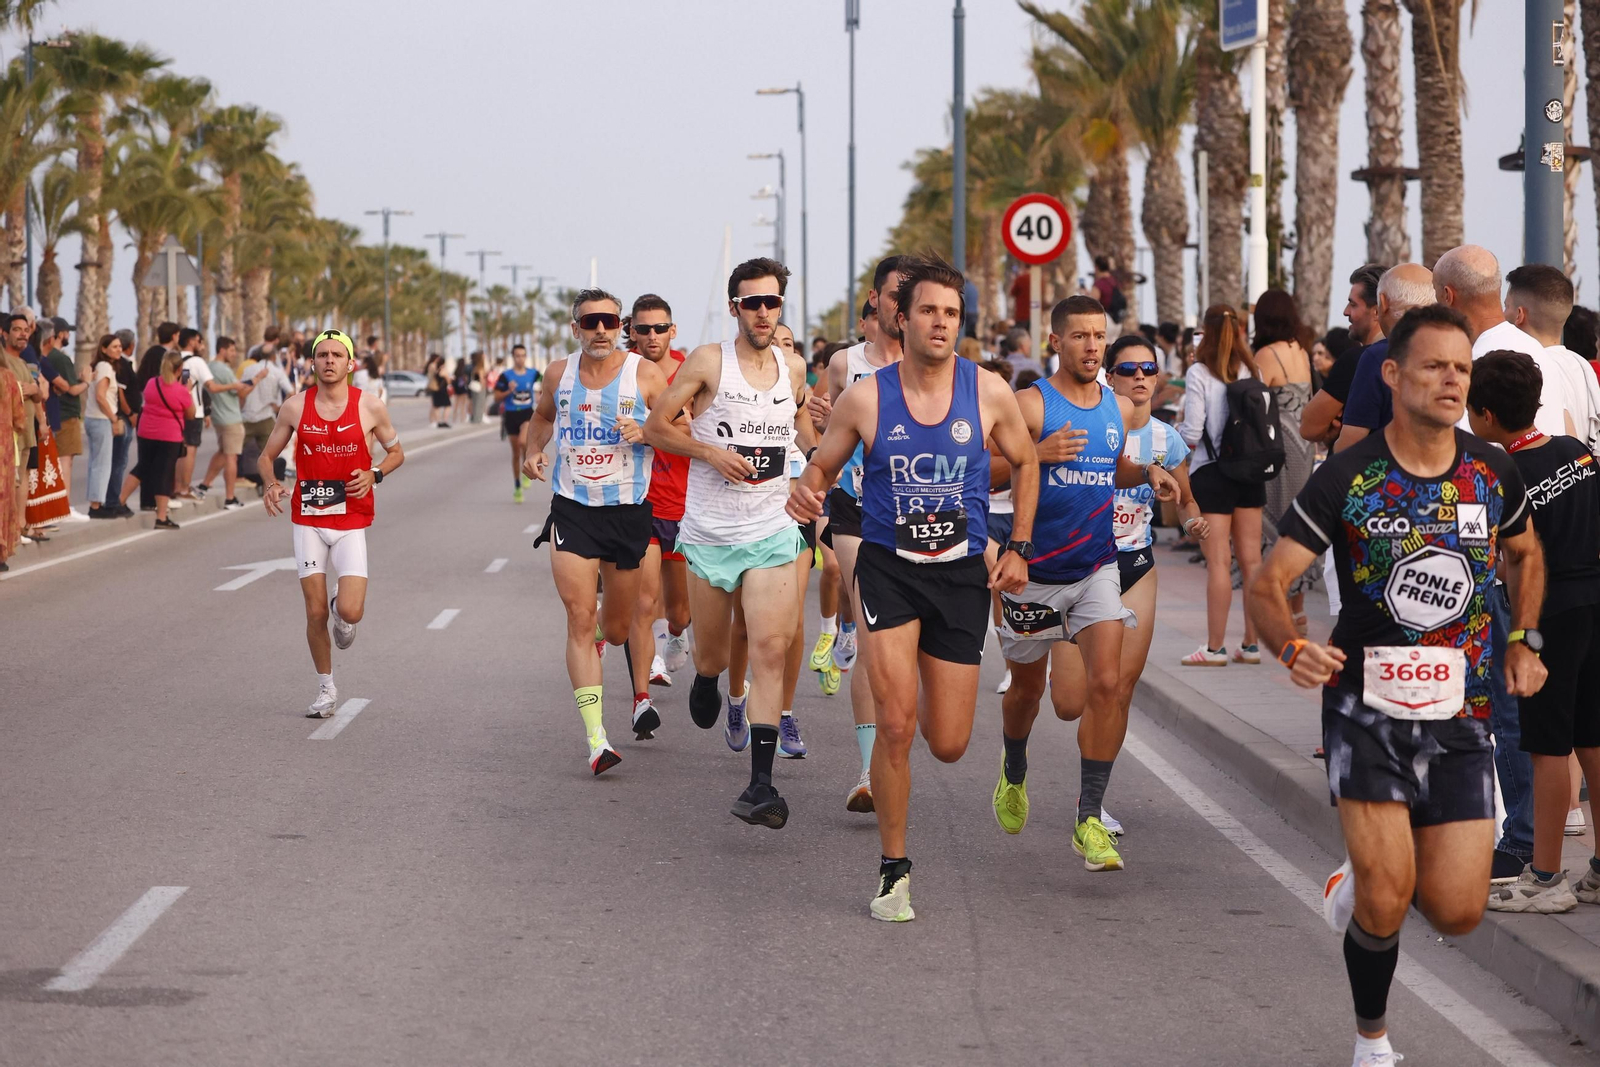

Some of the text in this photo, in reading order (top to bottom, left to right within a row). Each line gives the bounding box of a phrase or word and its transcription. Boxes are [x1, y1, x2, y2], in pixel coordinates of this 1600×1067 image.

[1017, 215, 1053, 241] 40
[560, 419, 620, 445] málag
[315, 442, 358, 453] abelenda
[576, 454, 614, 465] 3097
[889, 453, 967, 484] RCM
[309, 487, 335, 497] 988
[909, 521, 955, 539] 1332
[1459, 521, 1483, 535] AXA
[1460, 539, 1489, 547] fundación
[1403, 568, 1464, 595] PONLE
[1396, 584, 1457, 610] FRENO
[1007, 605, 1047, 621] 1037
[1379, 662, 1450, 681] 3668
